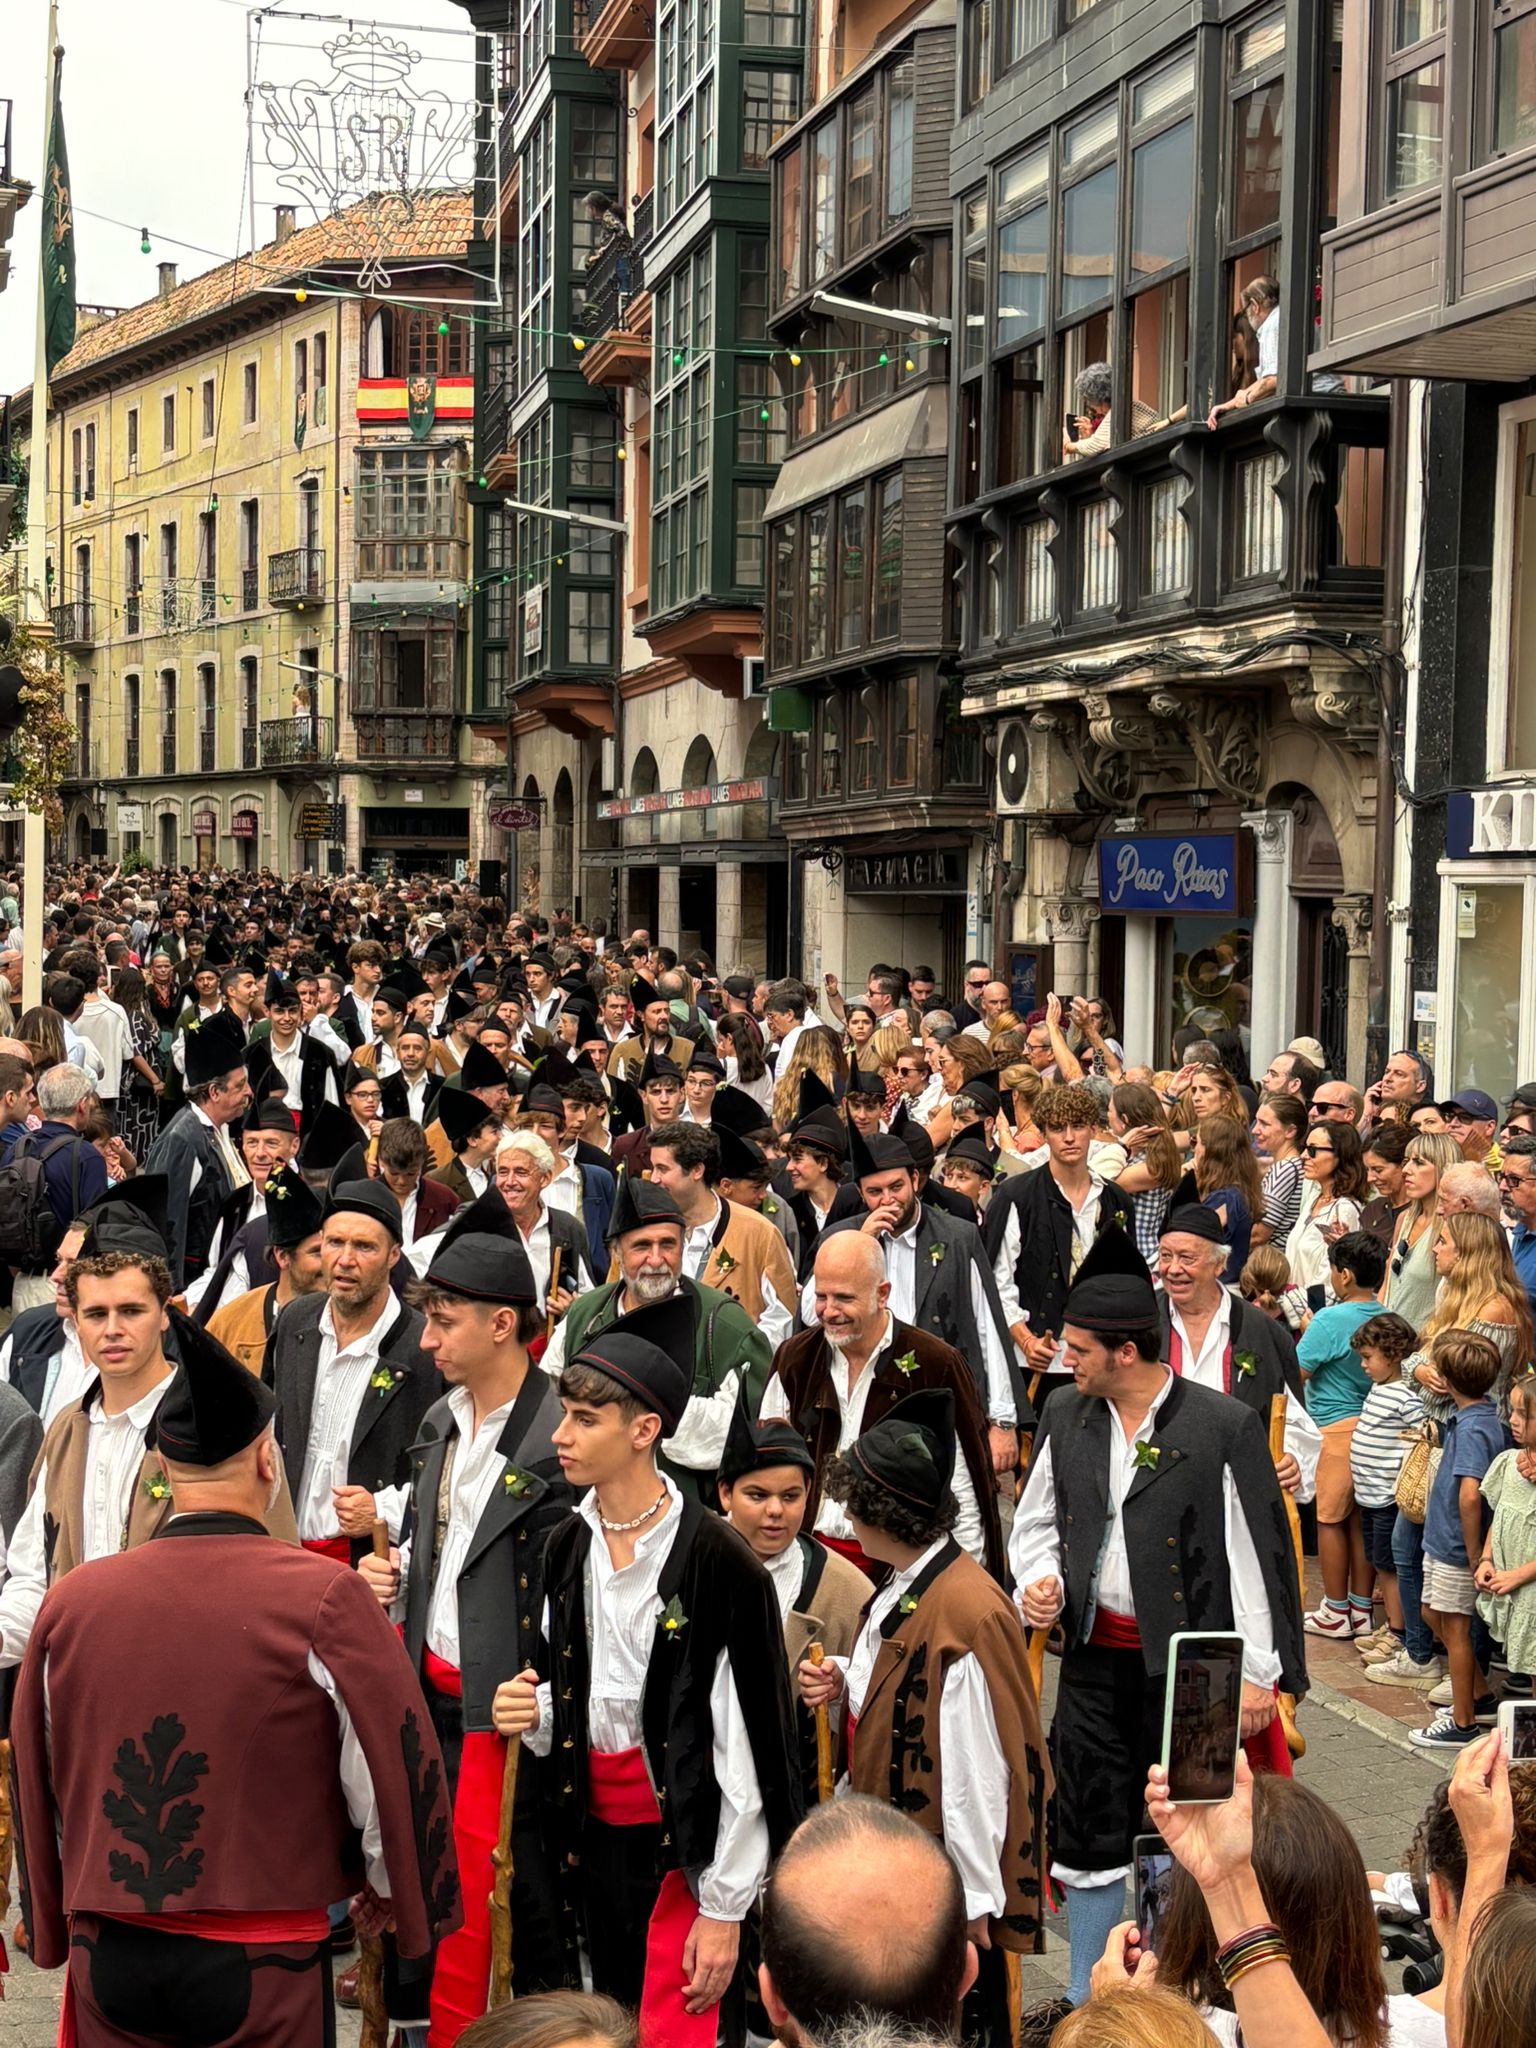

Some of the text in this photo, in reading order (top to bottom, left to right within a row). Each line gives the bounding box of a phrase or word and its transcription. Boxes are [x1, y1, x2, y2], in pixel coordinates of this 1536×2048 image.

[1469, 788, 1536, 853] KI
[1108, 842, 1229, 904] Paco Rozas
